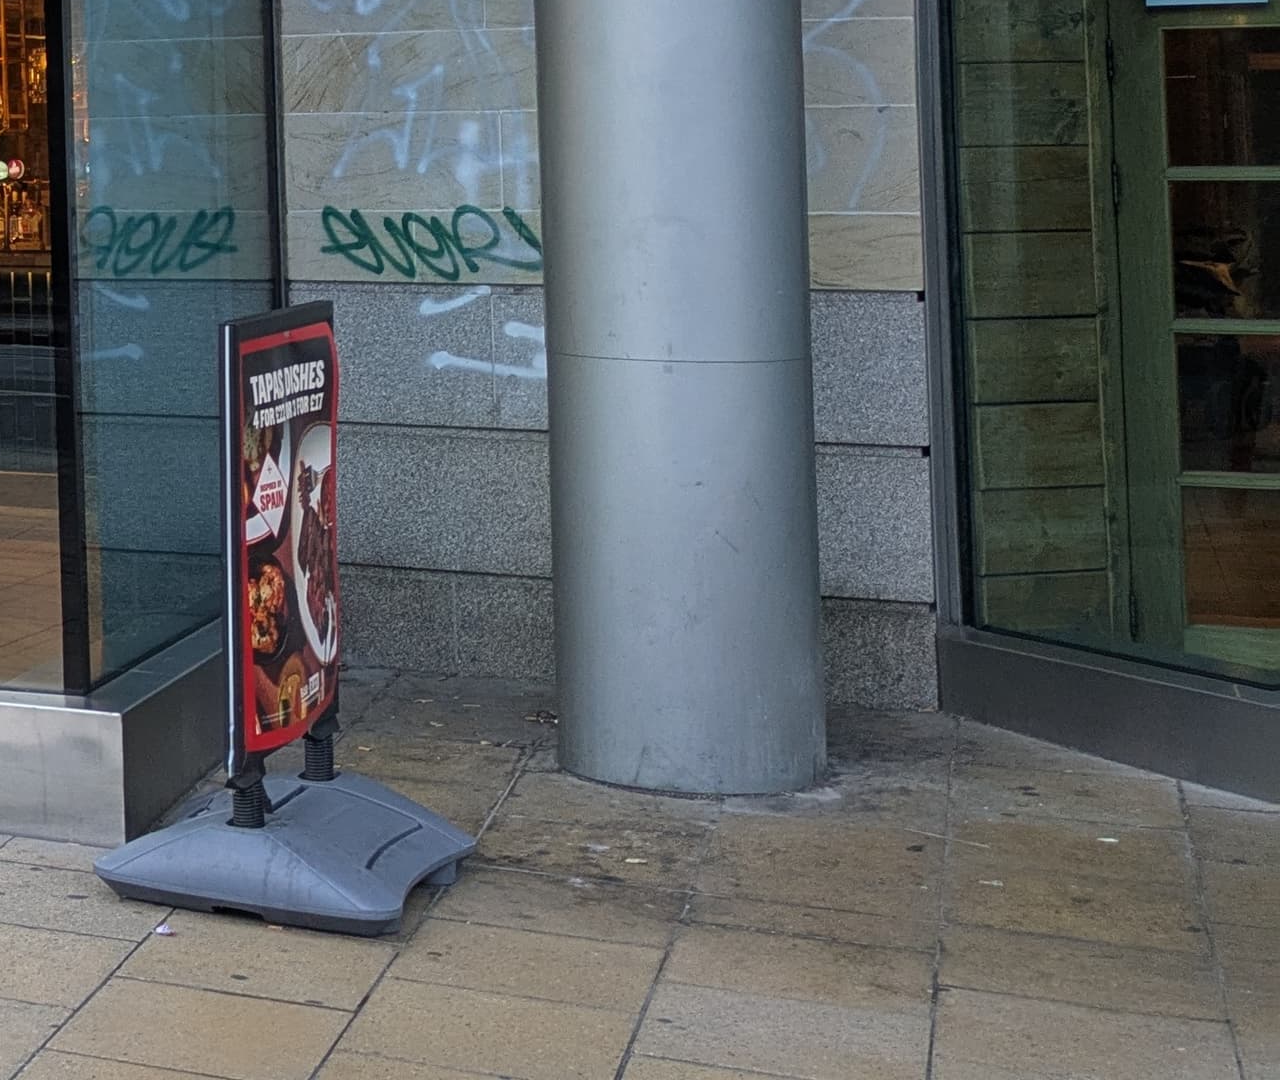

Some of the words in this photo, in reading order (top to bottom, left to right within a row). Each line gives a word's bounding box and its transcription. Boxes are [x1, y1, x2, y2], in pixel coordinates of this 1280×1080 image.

[249, 369, 284, 406] TAPAS
[284, 360, 325, 395] DISHES
[253, 410, 260, 430] 4
[260, 406, 276, 429] FOR
[297, 396, 309, 417] FOR
[310, 392, 325, 413] £17
[260, 488, 284, 513] SPAIN
